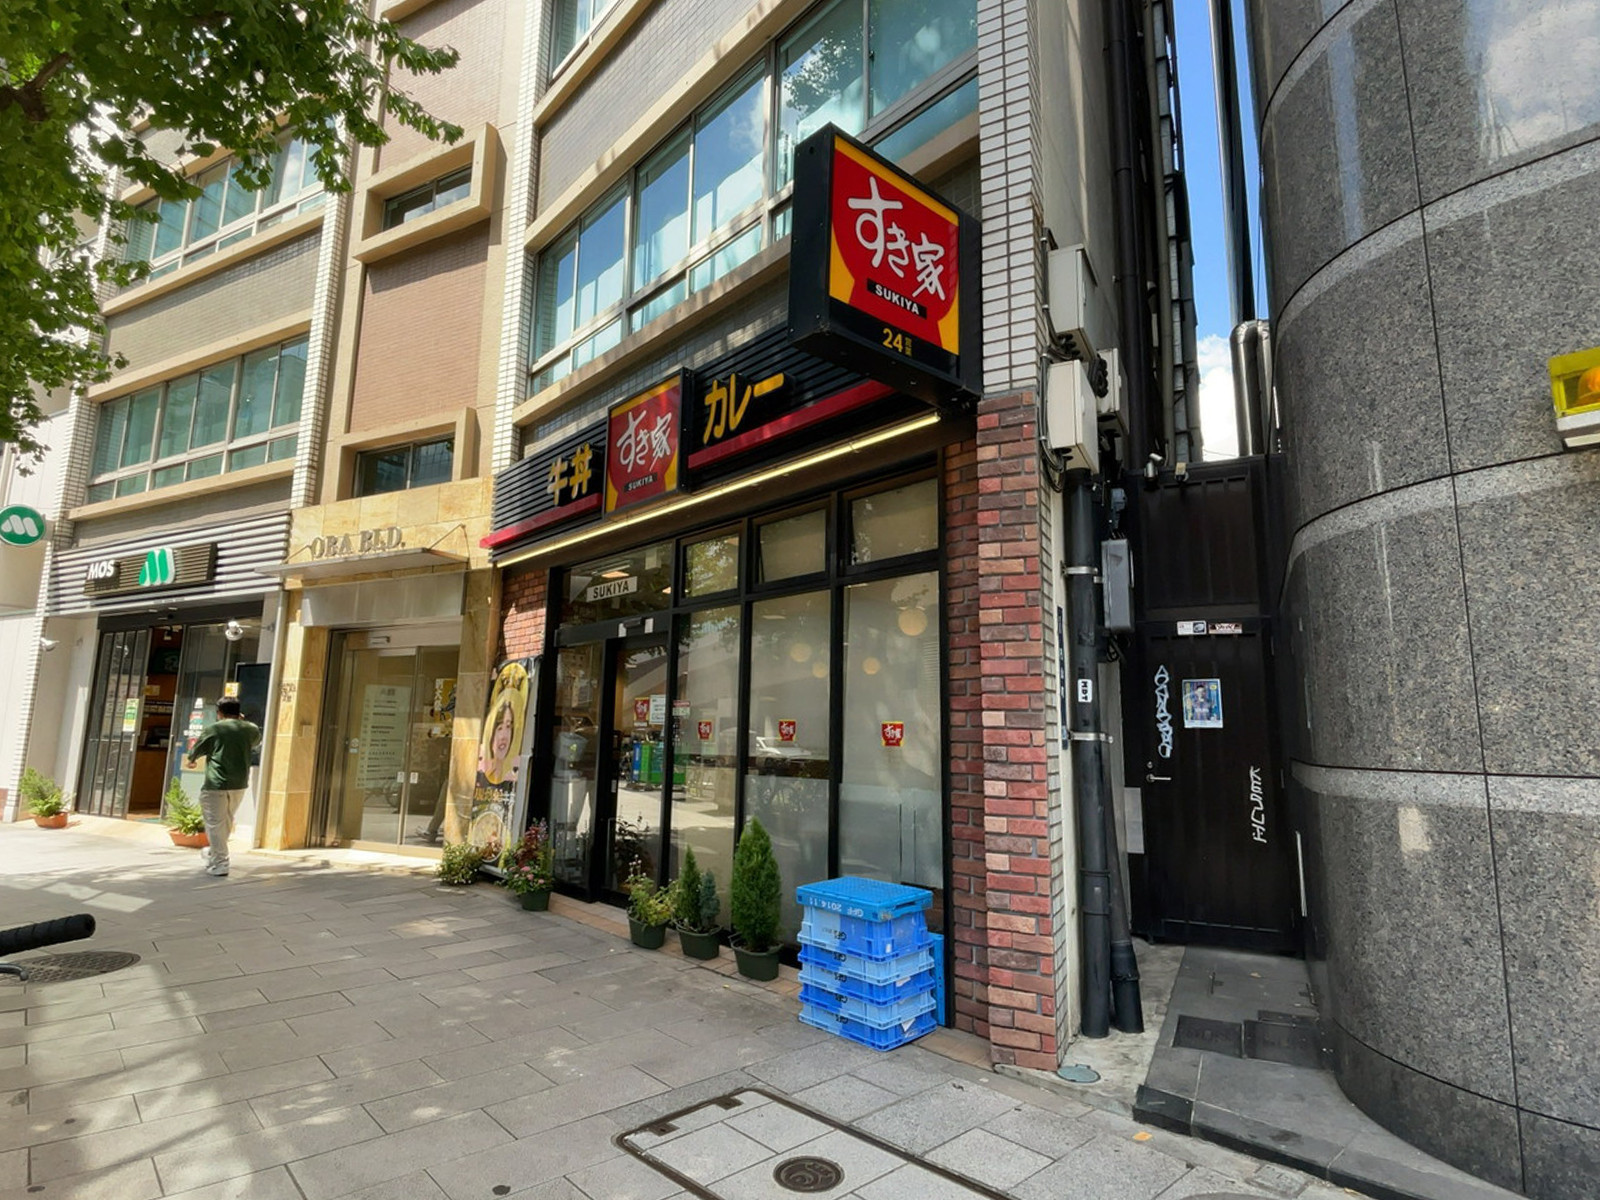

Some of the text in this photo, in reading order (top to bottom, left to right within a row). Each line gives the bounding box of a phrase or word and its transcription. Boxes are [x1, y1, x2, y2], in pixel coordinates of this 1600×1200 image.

[847, 176, 946, 301] すき家
[875, 284, 920, 315] SUKIYA
[703, 373, 784, 444] カレー
[616, 410, 672, 473] すき家
[547, 442, 593, 506] 牛丼
[627, 475, 654, 491] SUKIYA
[311, 527, 406, 559] OBA BLD.
[87, 560, 115, 580] MOS
[593, 580, 630, 599] SUKIYA
